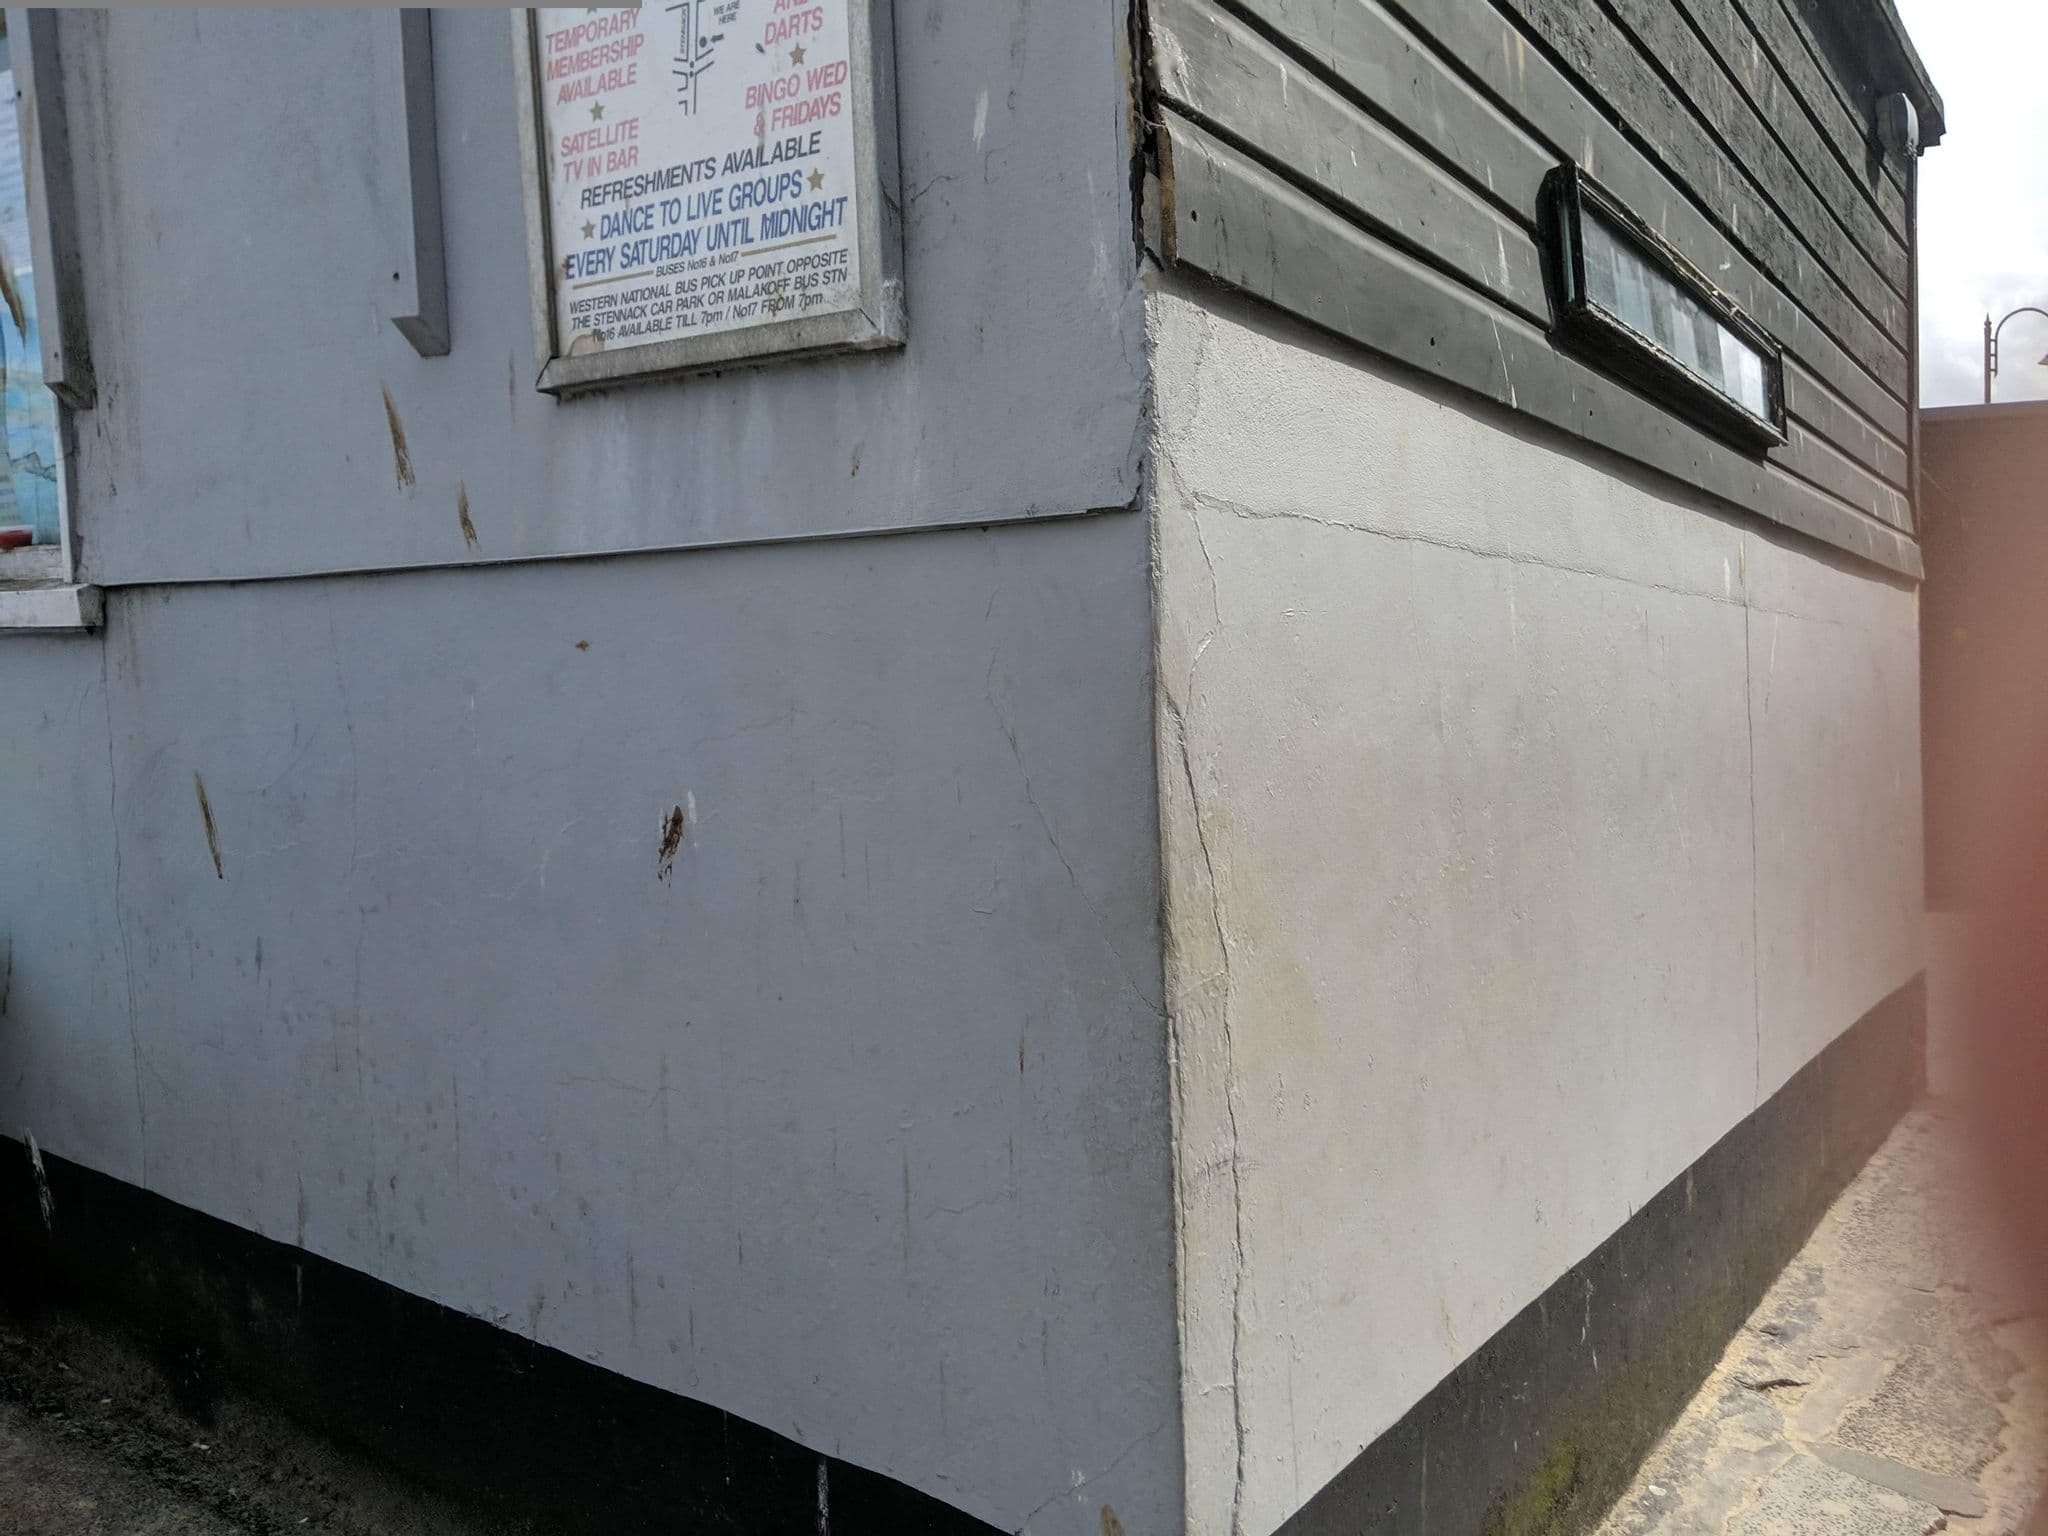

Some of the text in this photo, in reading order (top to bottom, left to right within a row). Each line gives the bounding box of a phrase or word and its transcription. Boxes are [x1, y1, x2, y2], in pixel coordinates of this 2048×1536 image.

[545, 8, 640, 55] TEMPORARY
[714, 4, 724, 16] WE
[718, 12, 737, 25] HERE
[764, 6, 823, 46] DARTS
[547, 33, 644, 80] MEMBERSHIP
[557, 62, 637, 105] AVAILABLE
[745, 60, 847, 109] BINGO WED
[561, 117, 639, 158] SATELLITE
[754, 91, 841, 137] & FRIDAYS
[563, 145, 639, 183] TV IN BAR
[580, 130, 822, 210] REFRESHMENTS AVAILABLE
[600, 169, 803, 241] DANCE TO LIVE GROUPS
[565, 196, 848, 280] EVERY SATURDAY UNTIL MIDNIGHT
[569, 248, 848, 314] WESTERN NATIONAL BUS PICK UP POINT OPPOSITE
[656, 261, 685, 278] BUSES
[709, 255, 716, 267] &
[719, 250, 739, 265] No17
[571, 267, 848, 329] THE STENNACK CAR PARK OR MALAKOFF BUS STN
[617, 317, 673, 339] AVAILABLE
[676, 310, 698, 328] TILL
[701, 310, 723, 327] 7pm
[732, 302, 758, 319] No17
[761, 294, 795, 315] FROM
[798, 292, 824, 312] 7pm
